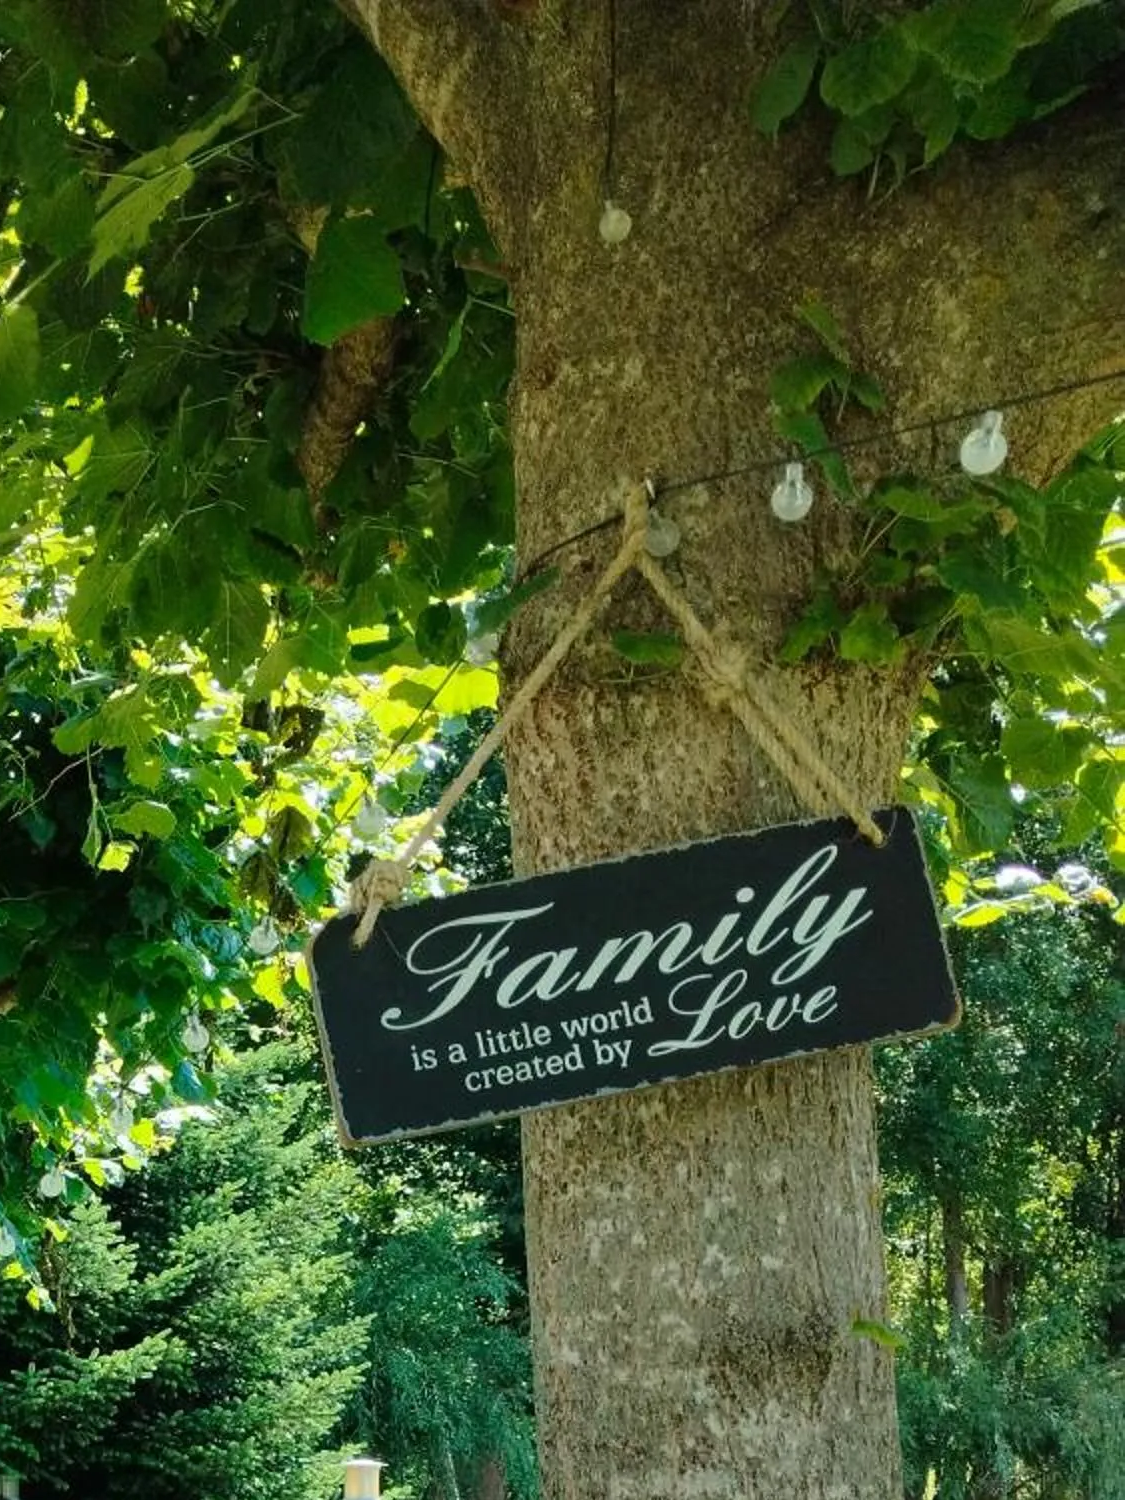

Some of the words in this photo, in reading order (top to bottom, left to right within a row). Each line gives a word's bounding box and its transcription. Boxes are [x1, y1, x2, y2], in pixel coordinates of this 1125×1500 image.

[380, 844, 873, 1031] Family
[410, 1044, 438, 1072] is
[448, 1042, 467, 1064] a
[475, 1022, 552, 1059] little
[560, 996, 655, 1041] world
[464, 1044, 585, 1092] created
[592, 1039, 633, 1068] by
[648, 968, 839, 1058] Love
